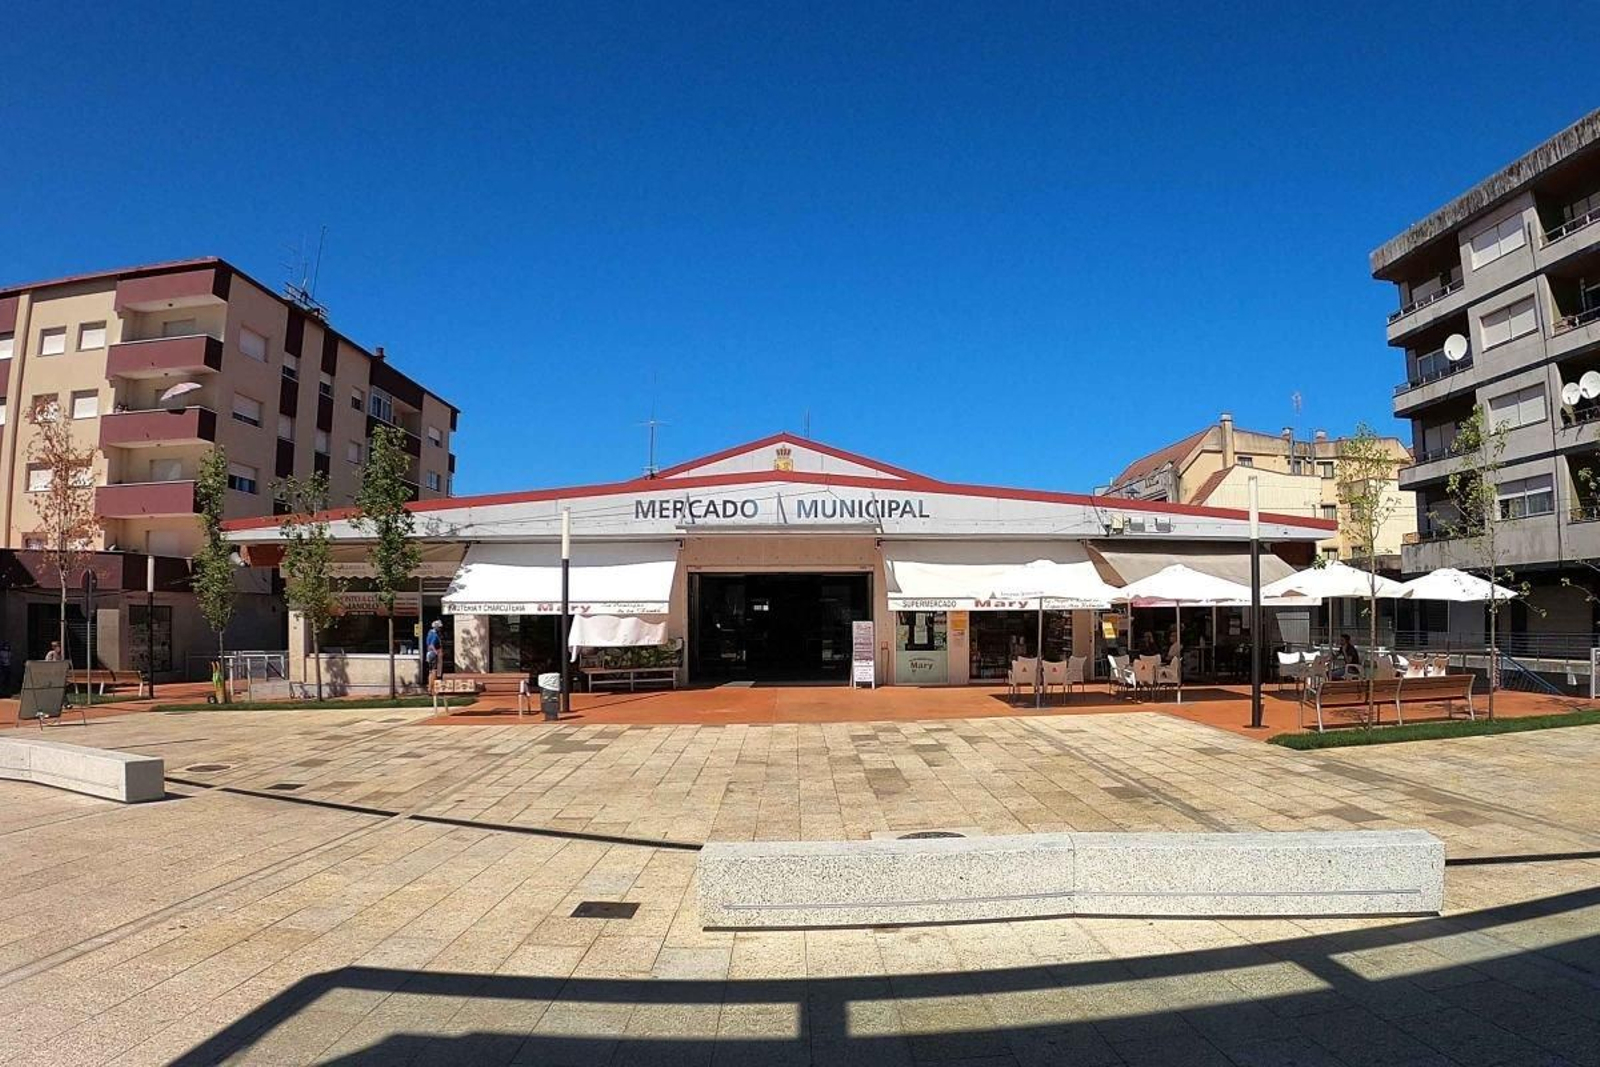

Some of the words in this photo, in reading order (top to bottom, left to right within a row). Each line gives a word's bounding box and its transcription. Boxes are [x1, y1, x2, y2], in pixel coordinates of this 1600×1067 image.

[635, 499, 759, 519] MERCADO
[797, 499, 930, 519] MUNICIPAL
[483, 604, 526, 612] CHARCUTERIA
[902, 599, 957, 608] SUPERMERCADO
[974, 599, 1029, 609] Mary
[910, 661, 933, 670] Mary
